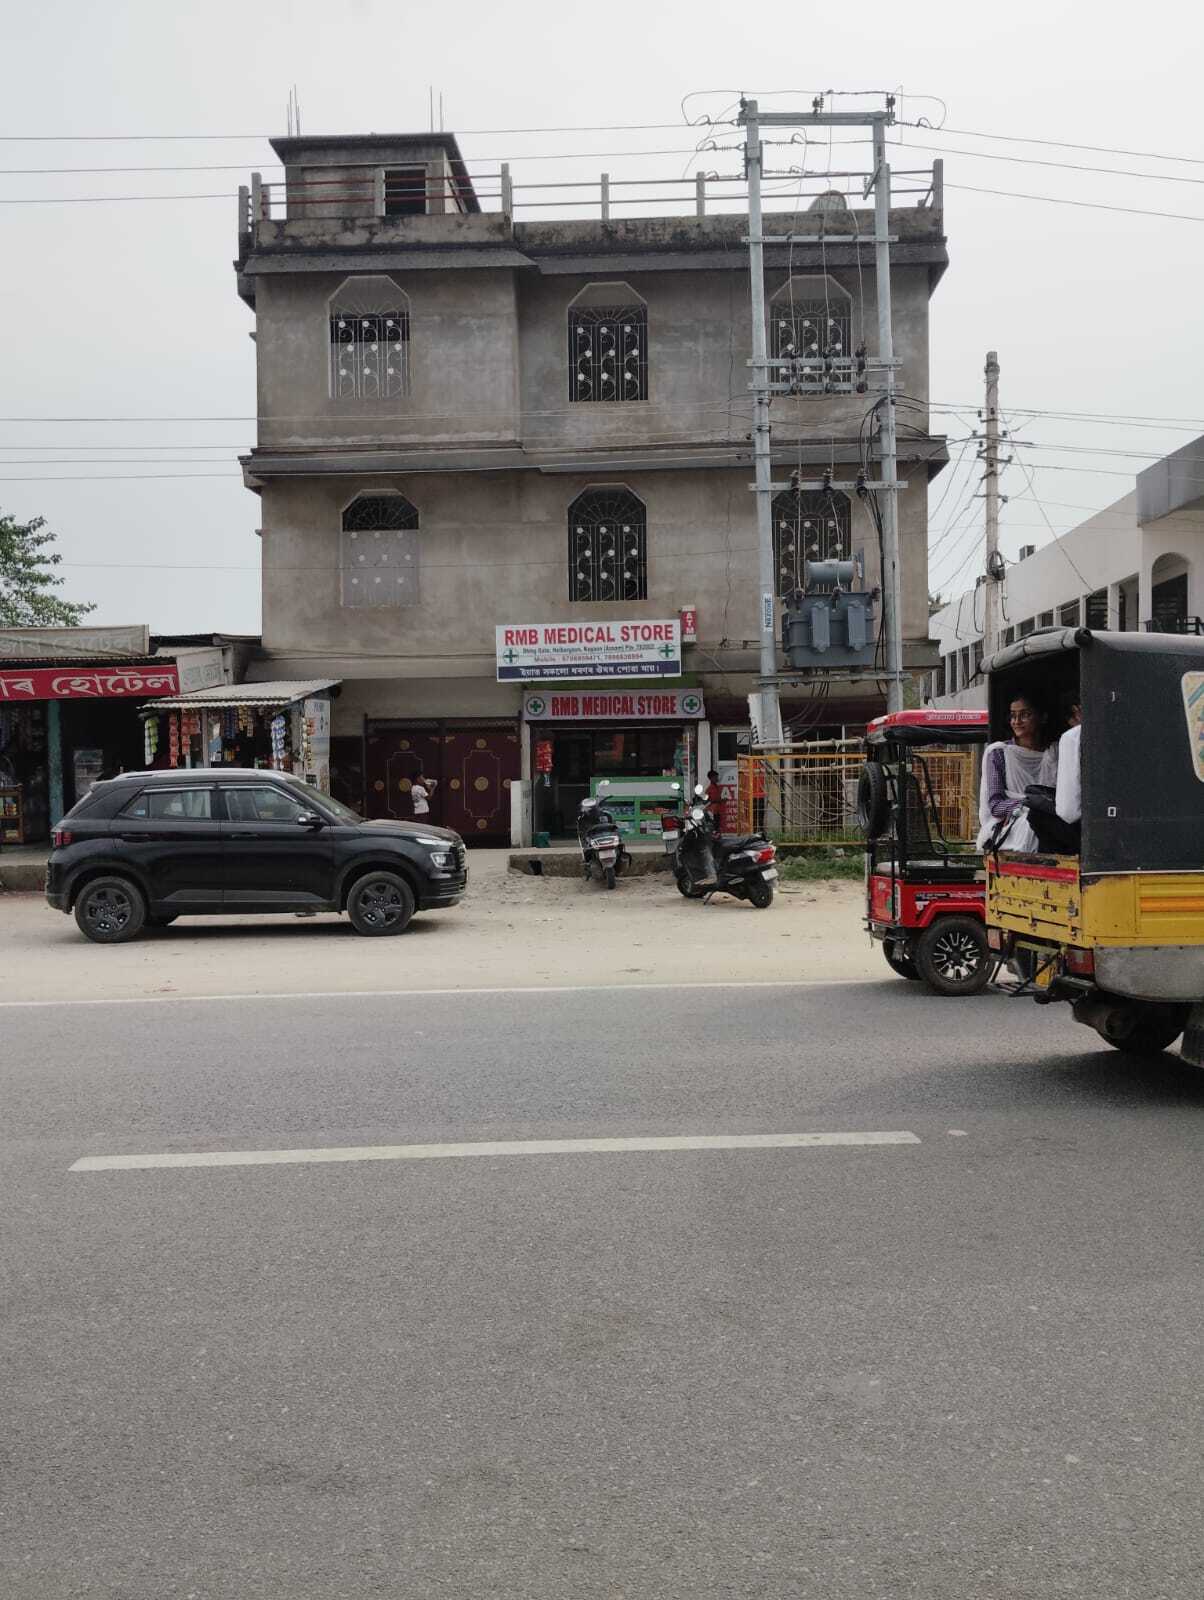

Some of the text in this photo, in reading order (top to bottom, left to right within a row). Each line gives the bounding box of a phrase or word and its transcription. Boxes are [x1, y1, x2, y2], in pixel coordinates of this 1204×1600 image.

[504, 624, 674, 646] RMB MEDICAL STORE
[51, 668, 177, 695] হোটেল
[551, 695, 677, 716] RMB MEDICAL STORE
